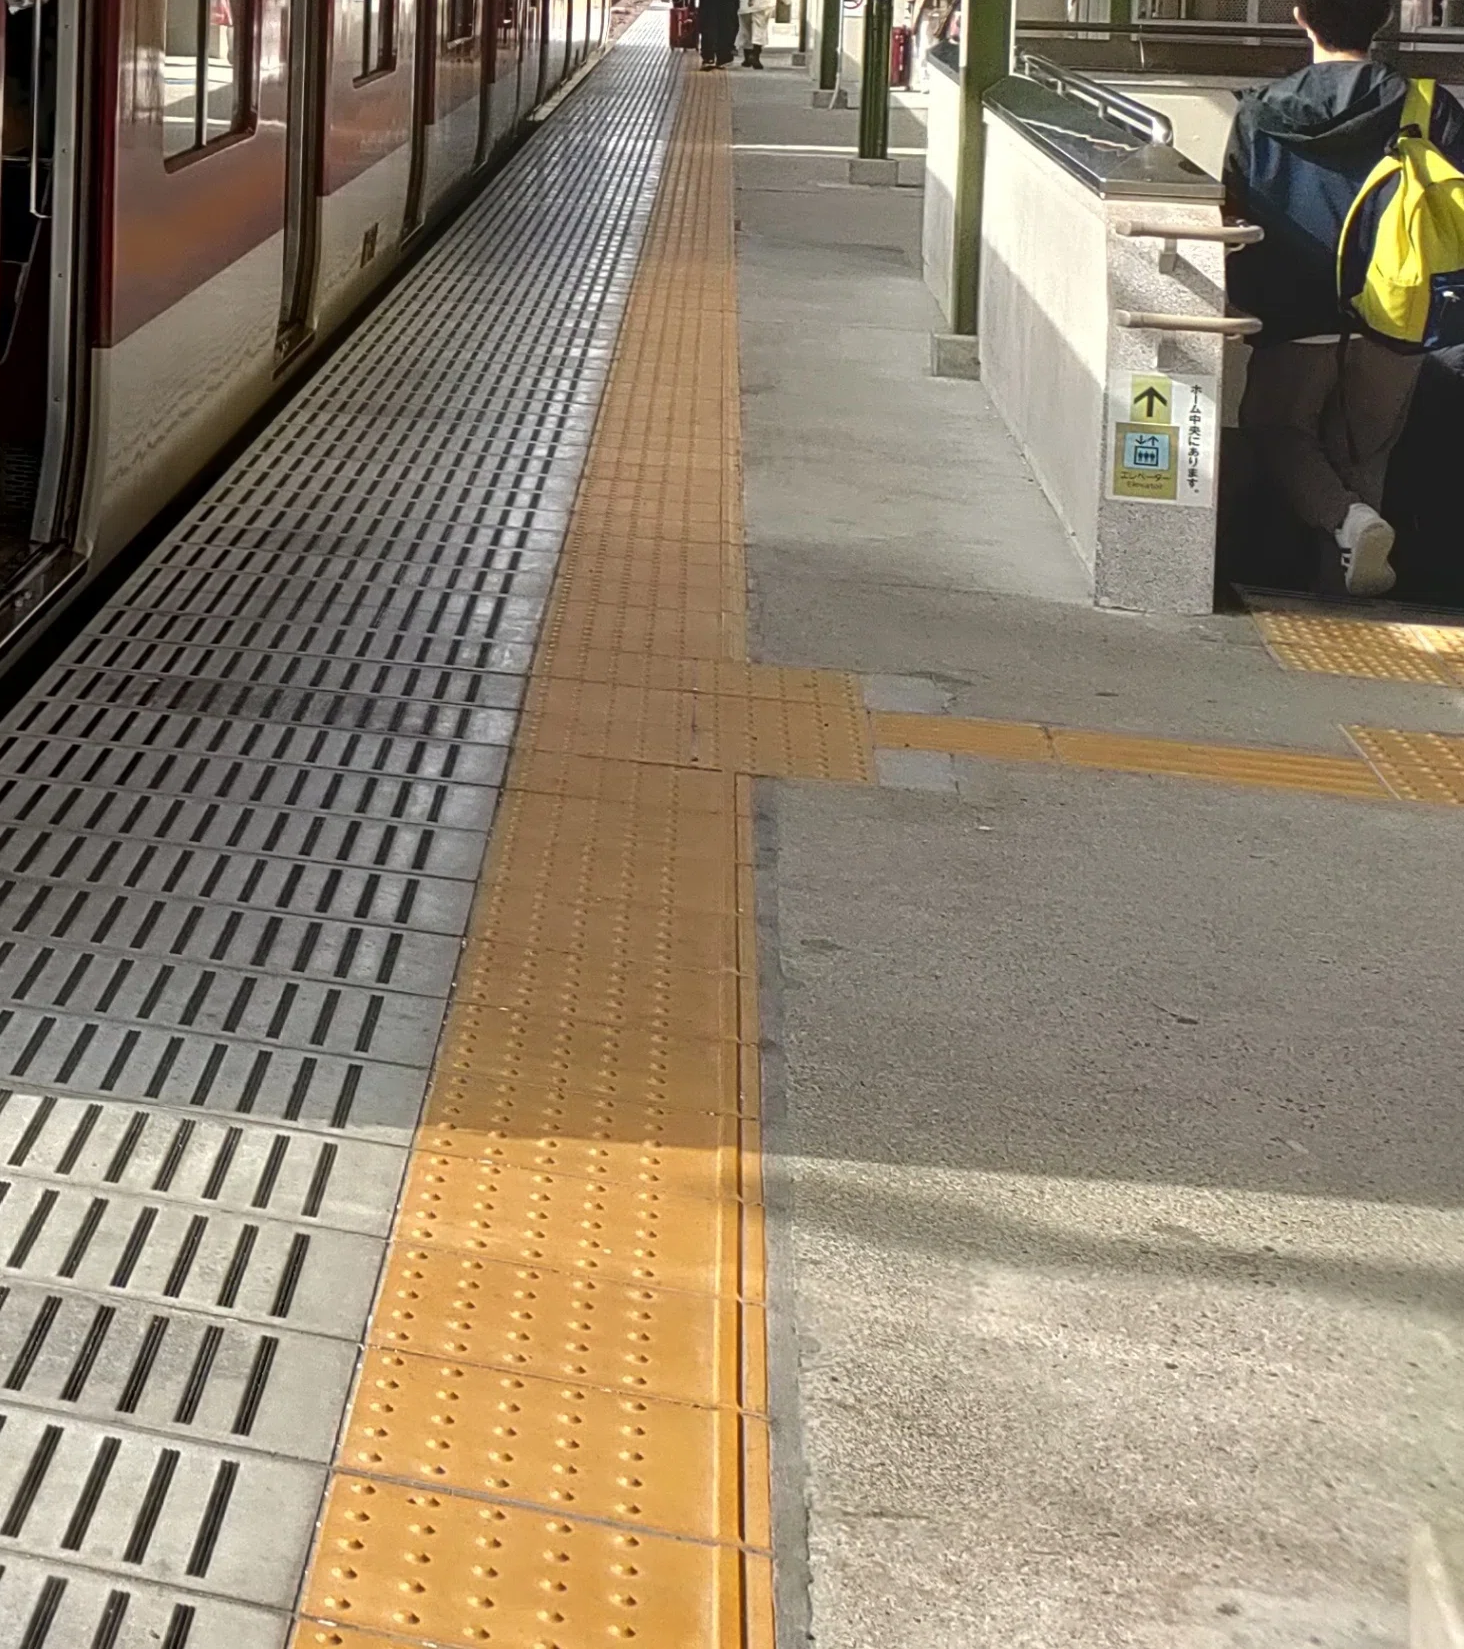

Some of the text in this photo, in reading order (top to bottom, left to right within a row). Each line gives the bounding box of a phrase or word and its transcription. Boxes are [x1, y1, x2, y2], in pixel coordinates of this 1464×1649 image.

[1187, 384, 1203, 494] ホーム中央にあります。
